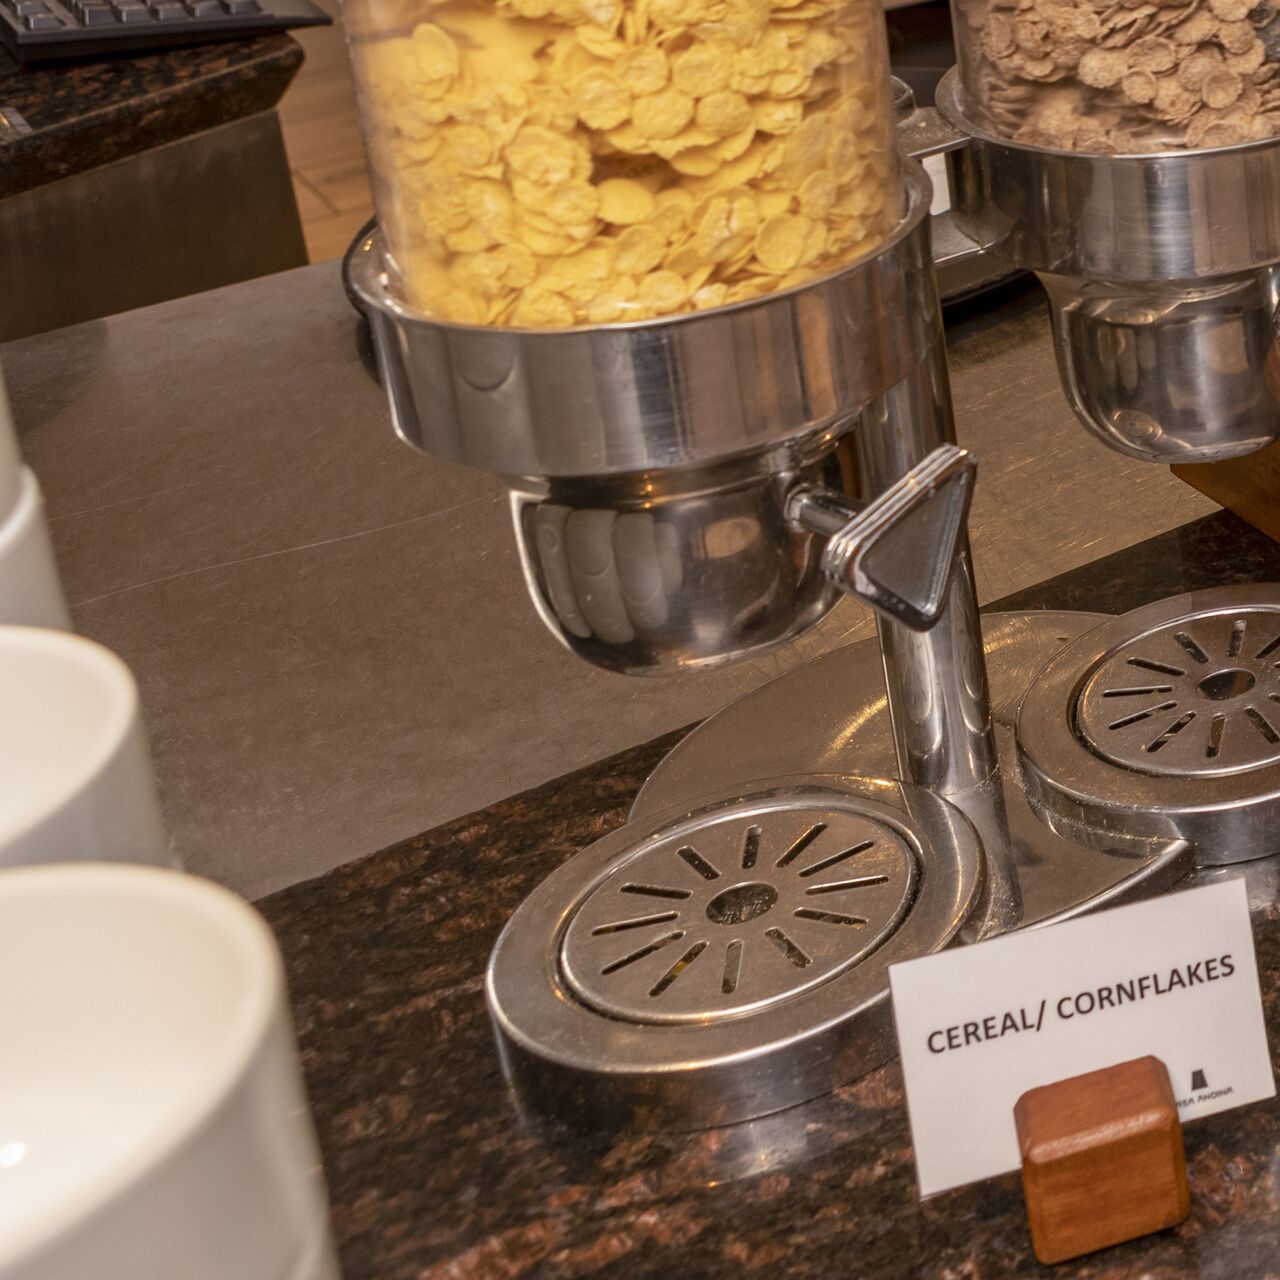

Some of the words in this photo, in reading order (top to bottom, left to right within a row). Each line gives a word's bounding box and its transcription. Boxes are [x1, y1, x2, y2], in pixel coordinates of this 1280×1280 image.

[927, 1000, 1046, 1054] CEREAL/
[1057, 954, 1235, 1020] CORNFLAKES
[1197, 1085, 1234, 1105] ANDINA
